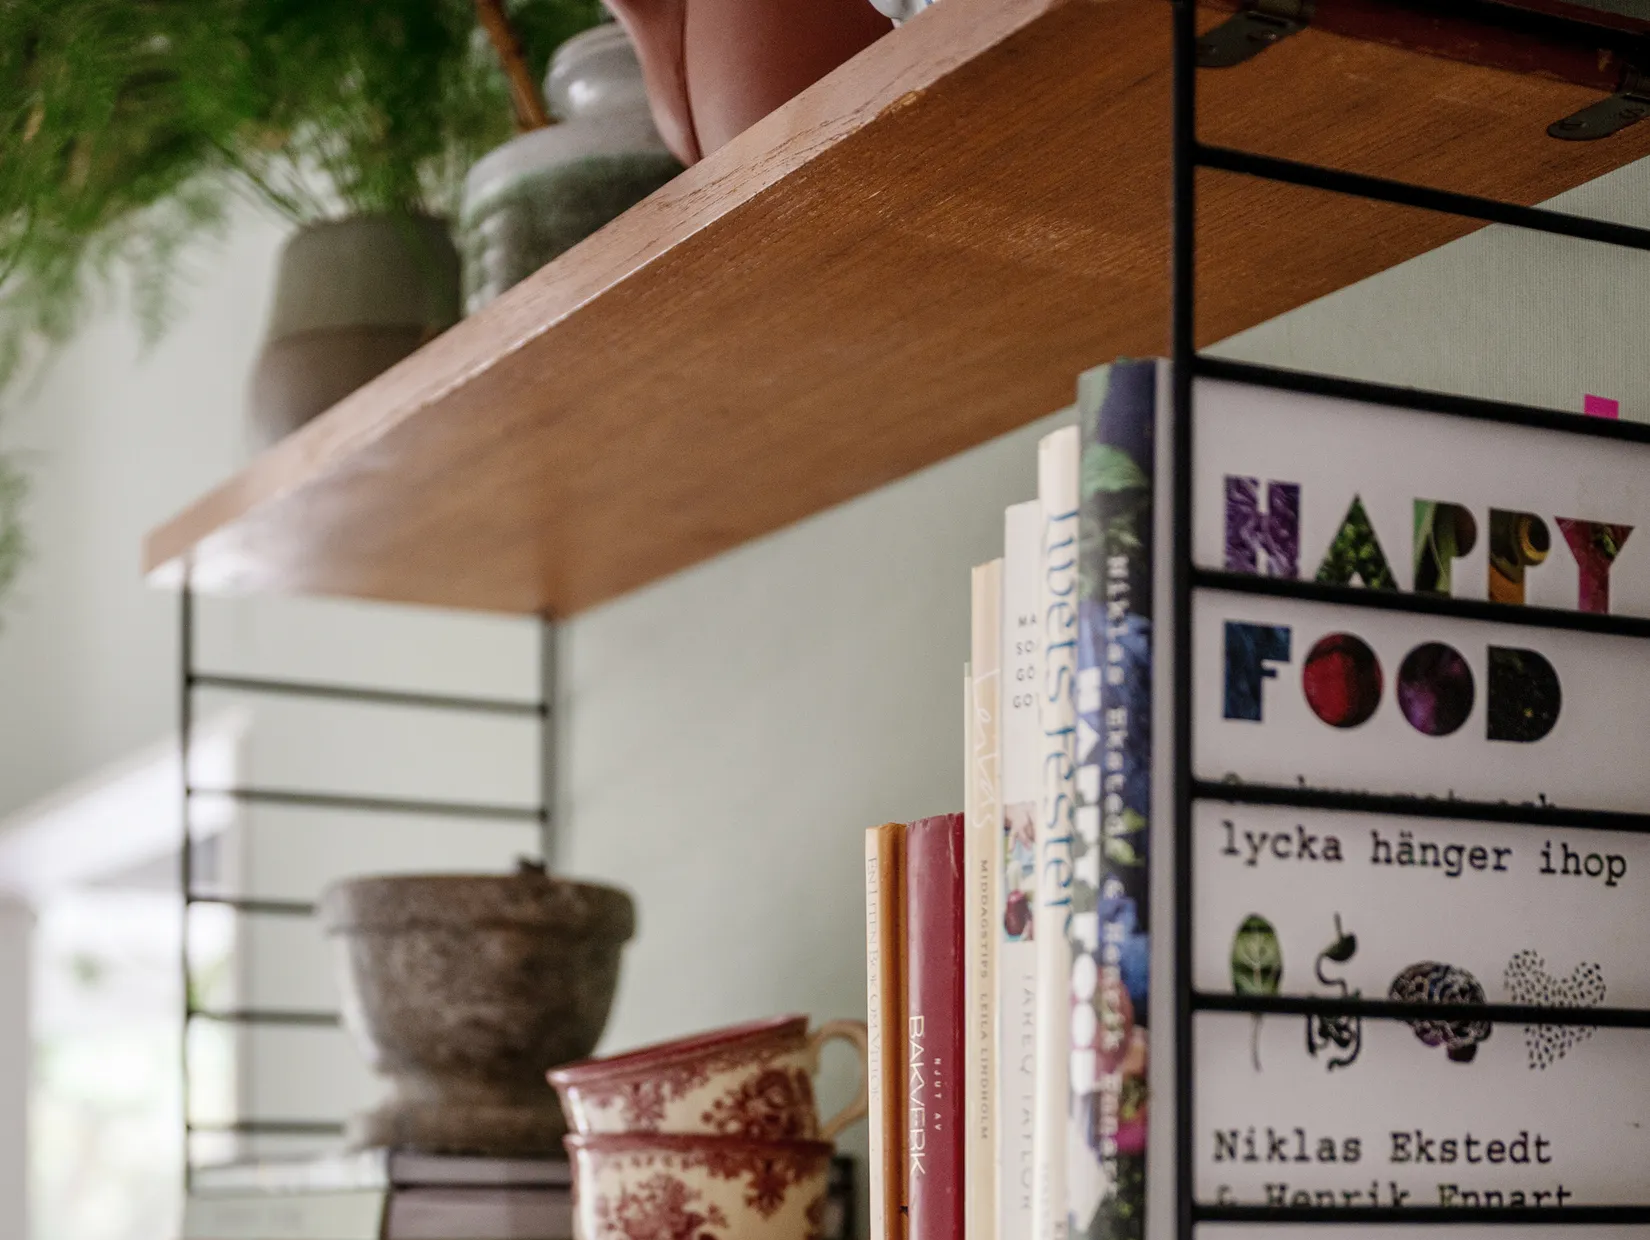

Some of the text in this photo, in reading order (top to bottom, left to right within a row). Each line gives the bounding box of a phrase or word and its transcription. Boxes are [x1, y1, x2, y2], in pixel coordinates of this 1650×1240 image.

[1223, 474, 1636, 614] HAPPY
[1223, 620, 1563, 744] FOOD
[1222, 820, 1628, 887] lycka hänger ihop
[979, 859, 989, 1140] MIDDAGSTIPS LEILA LINDHOLM
[909, 1014, 926, 1176] BAKVERK
[933, 1057, 942, 1132] NJUT AV
[1212, 1126, 1554, 1164] Niklas Ekstedt
[1263, 1180, 1411, 1208] Henrik
[1437, 1183, 1573, 1208] Ennart
